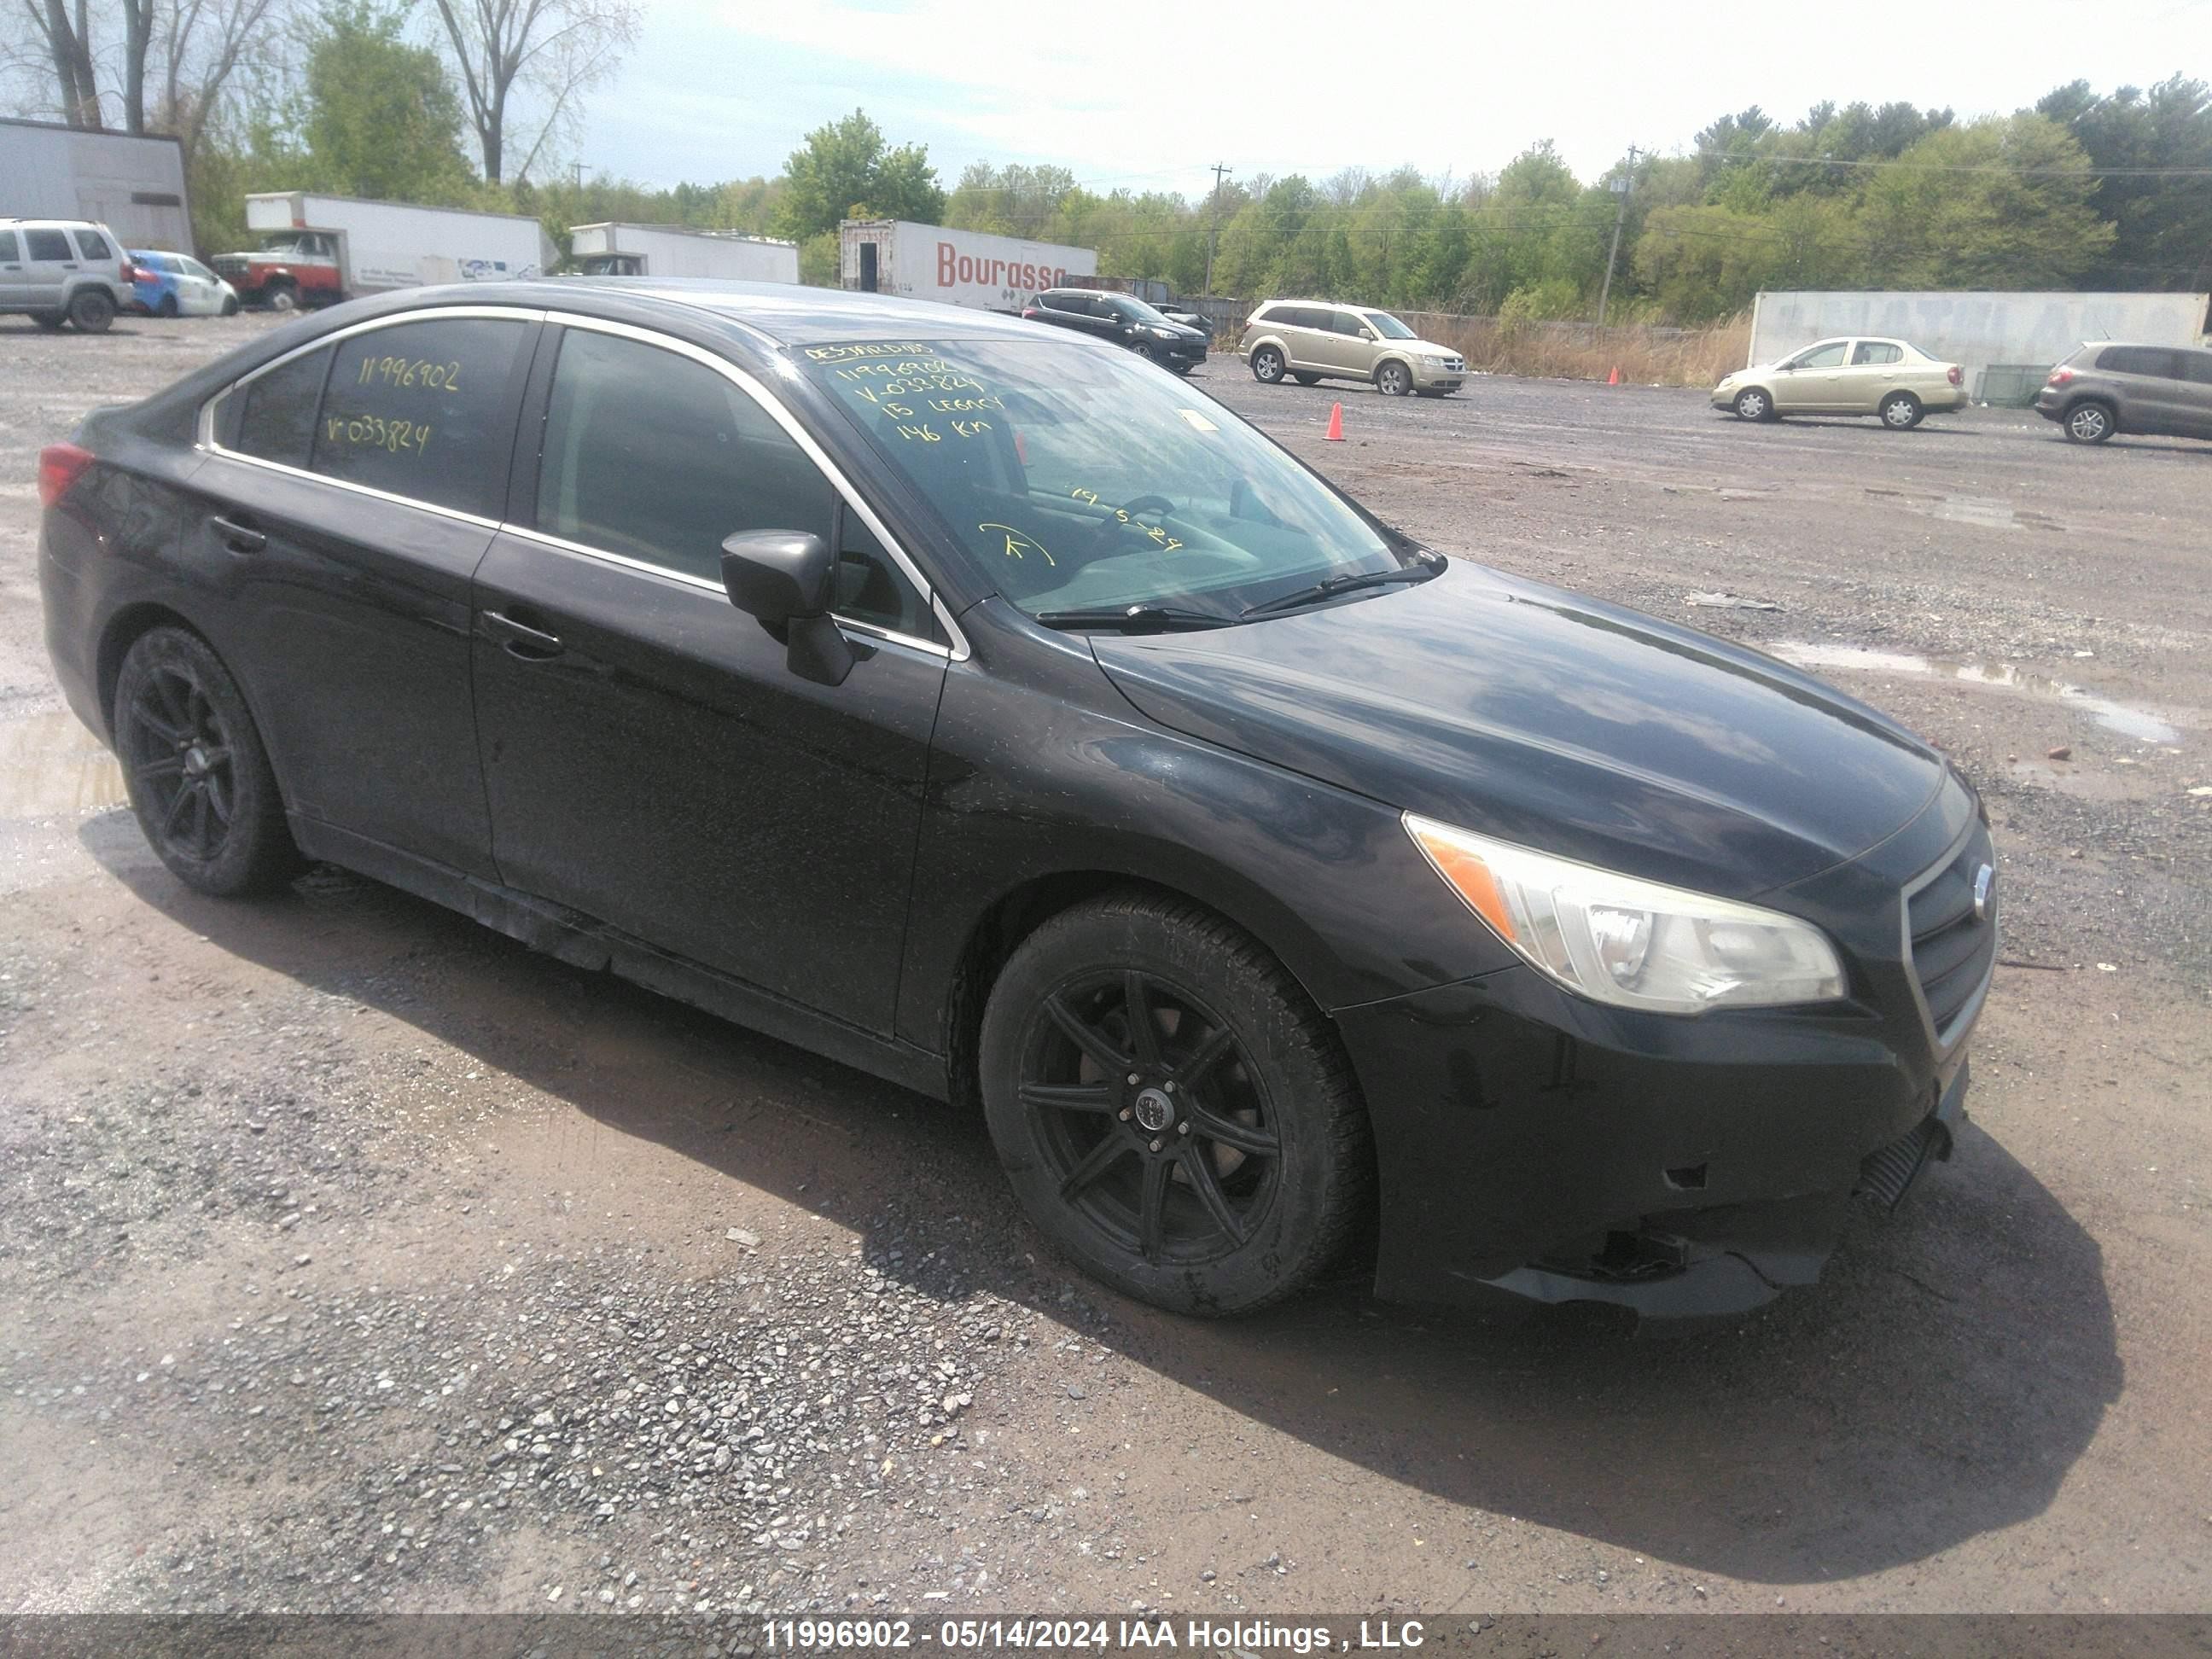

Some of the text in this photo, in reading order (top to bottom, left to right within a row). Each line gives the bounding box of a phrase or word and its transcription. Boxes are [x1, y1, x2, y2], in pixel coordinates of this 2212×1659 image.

[936, 242, 1066, 291] Bourassa
[358, 357, 460, 391] 11996902
[836, 360, 958, 381] 11996902
[882, 395, 1005, 420] 15 LEGACY
[896, 424, 941, 441] 146
